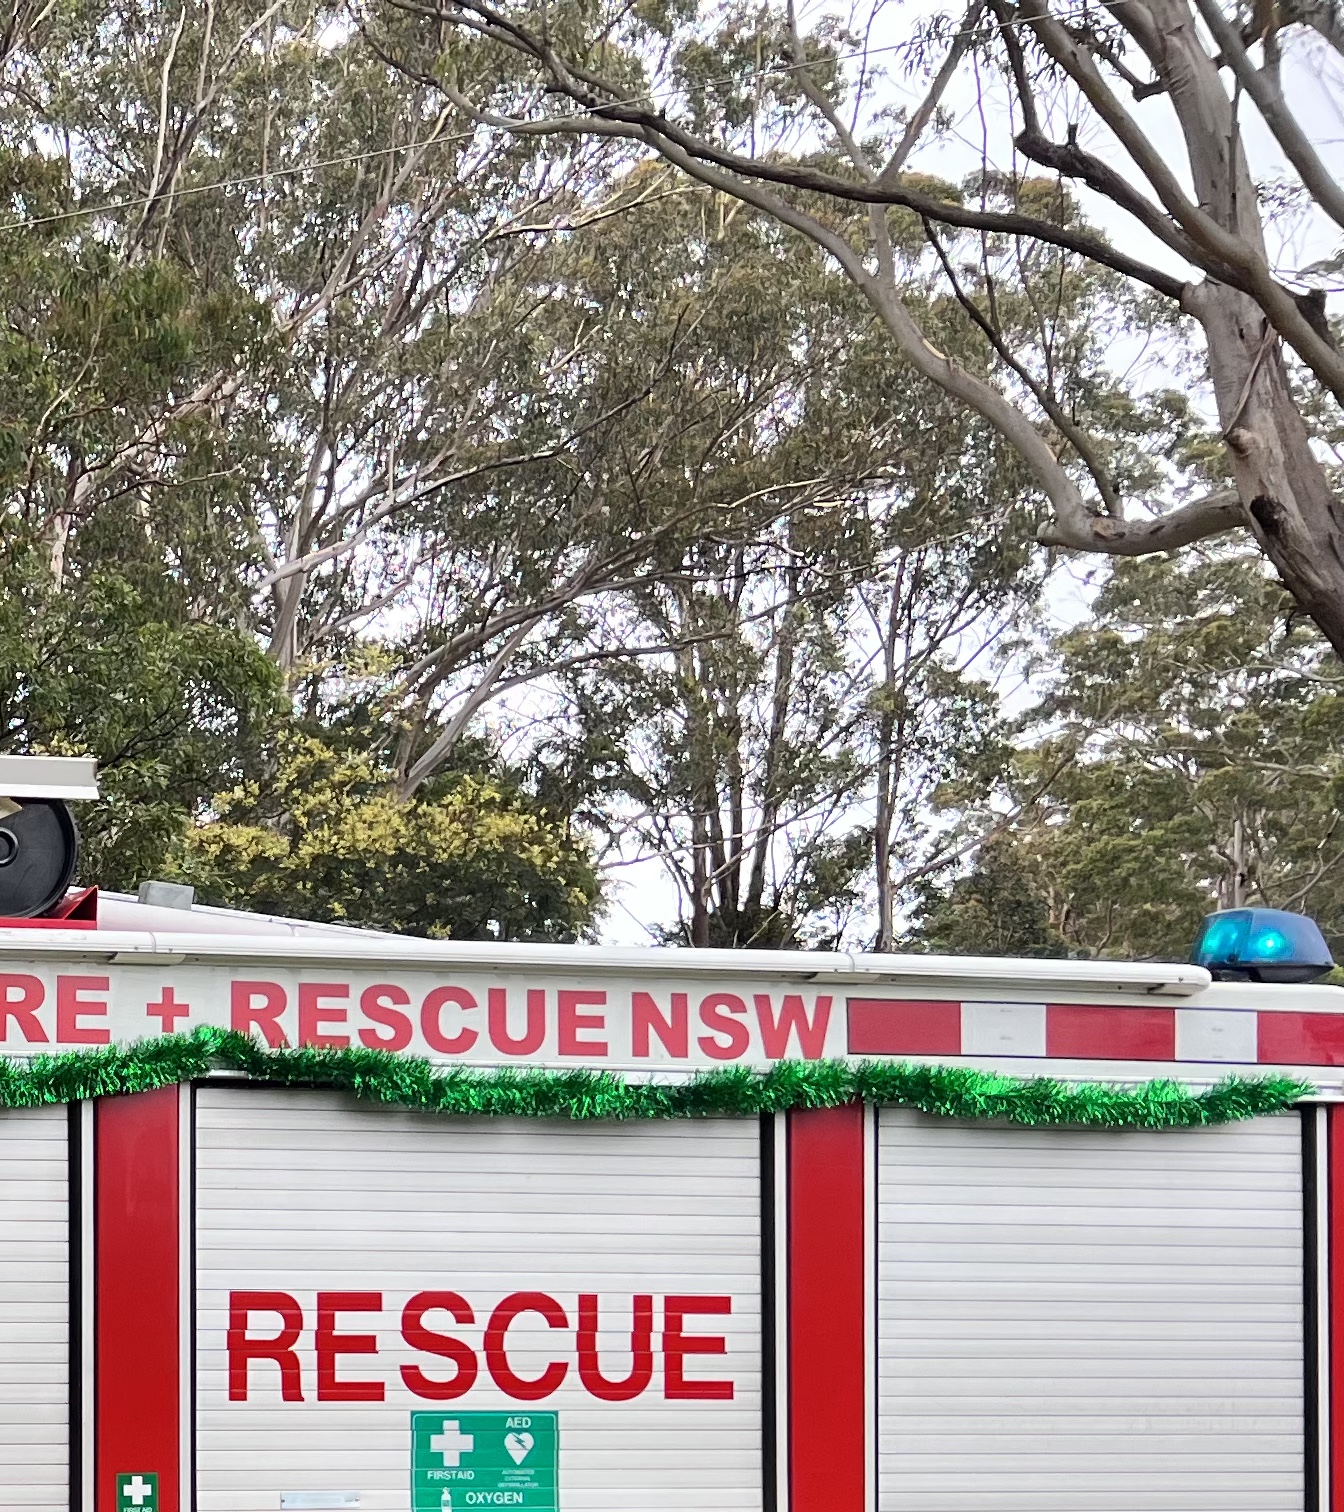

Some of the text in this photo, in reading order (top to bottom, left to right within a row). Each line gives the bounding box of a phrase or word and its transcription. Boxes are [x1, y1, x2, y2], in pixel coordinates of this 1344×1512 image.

[231, 980, 607, 1055] RESCUE
[633, 992, 832, 1060] NSW
[226, 1290, 735, 1402] RESCUE
[505, 1416, 532, 1429] AED
[465, 1491, 523, 1504] OXYGEN
